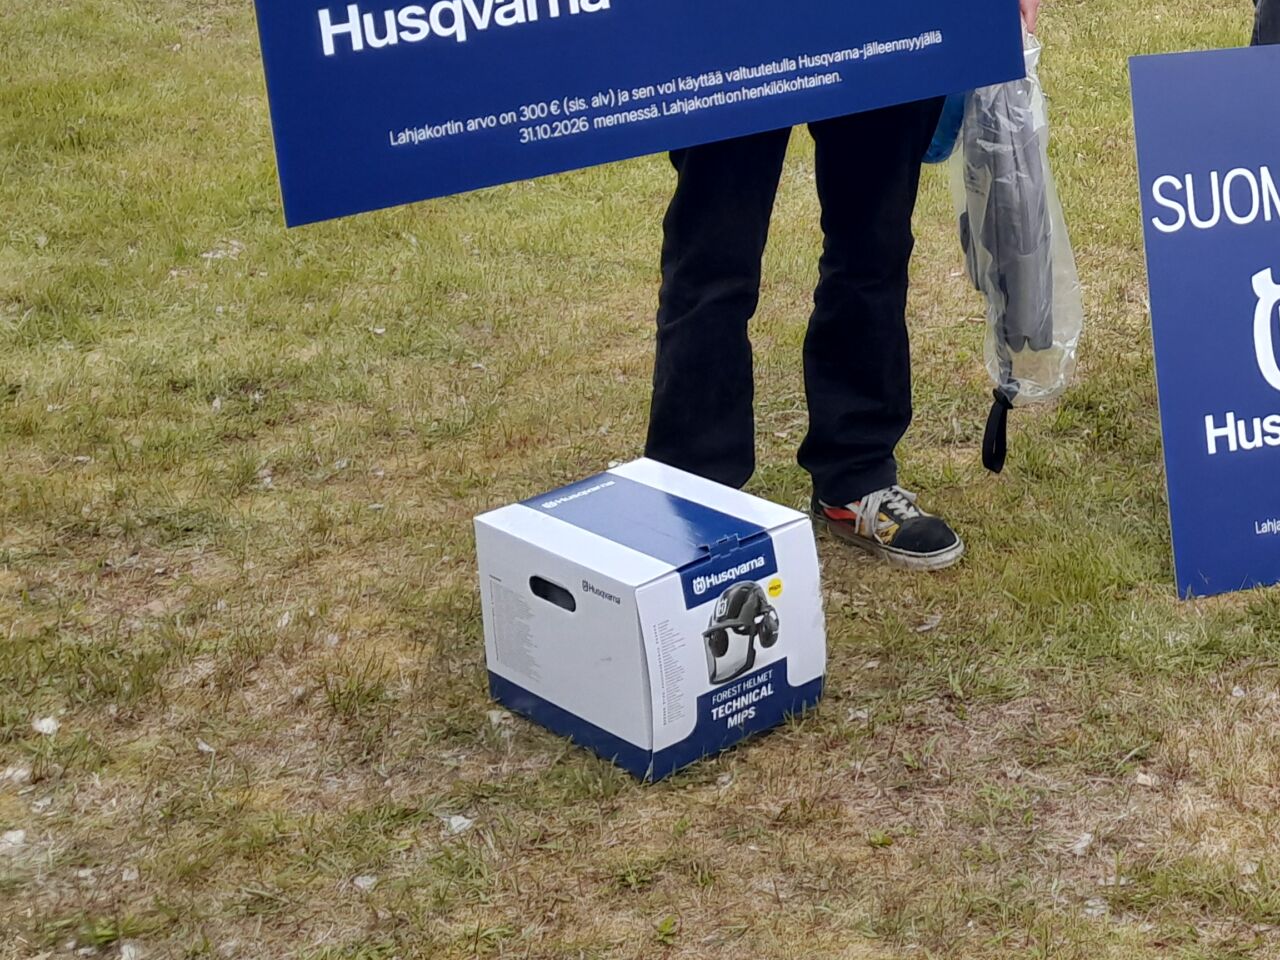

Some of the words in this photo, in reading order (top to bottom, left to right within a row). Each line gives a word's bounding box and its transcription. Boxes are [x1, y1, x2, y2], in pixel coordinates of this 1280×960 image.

[389, 119, 464, 146] Lahjakortin
[466, 115, 497, 132] arvo
[499, 111, 517, 125] on
[519, 102, 548, 122] 300
[549, 99, 561, 115] €
[563, 96, 589, 116] (sis.
[591, 88, 615, 108] alv)
[617, 89, 630, 106] ja
[631, 85, 655, 100] sen
[656, 78, 676, 95] voi
[677, 70, 724, 92] käyttää
[724, 58, 797, 82] valtuutetulla
[519, 116, 590, 144] 31.10.2026
[593, 103, 661, 129] mennessä.
[662, 91, 726, 116] Lahjakortti
[706, 556, 765, 589] Husqvarna
[711, 683, 774, 720] TECHNICAL
[712, 683, 741, 705] FOREST
[743, 669, 773, 691] HELMET
[727, 706, 756, 729] MIPS
